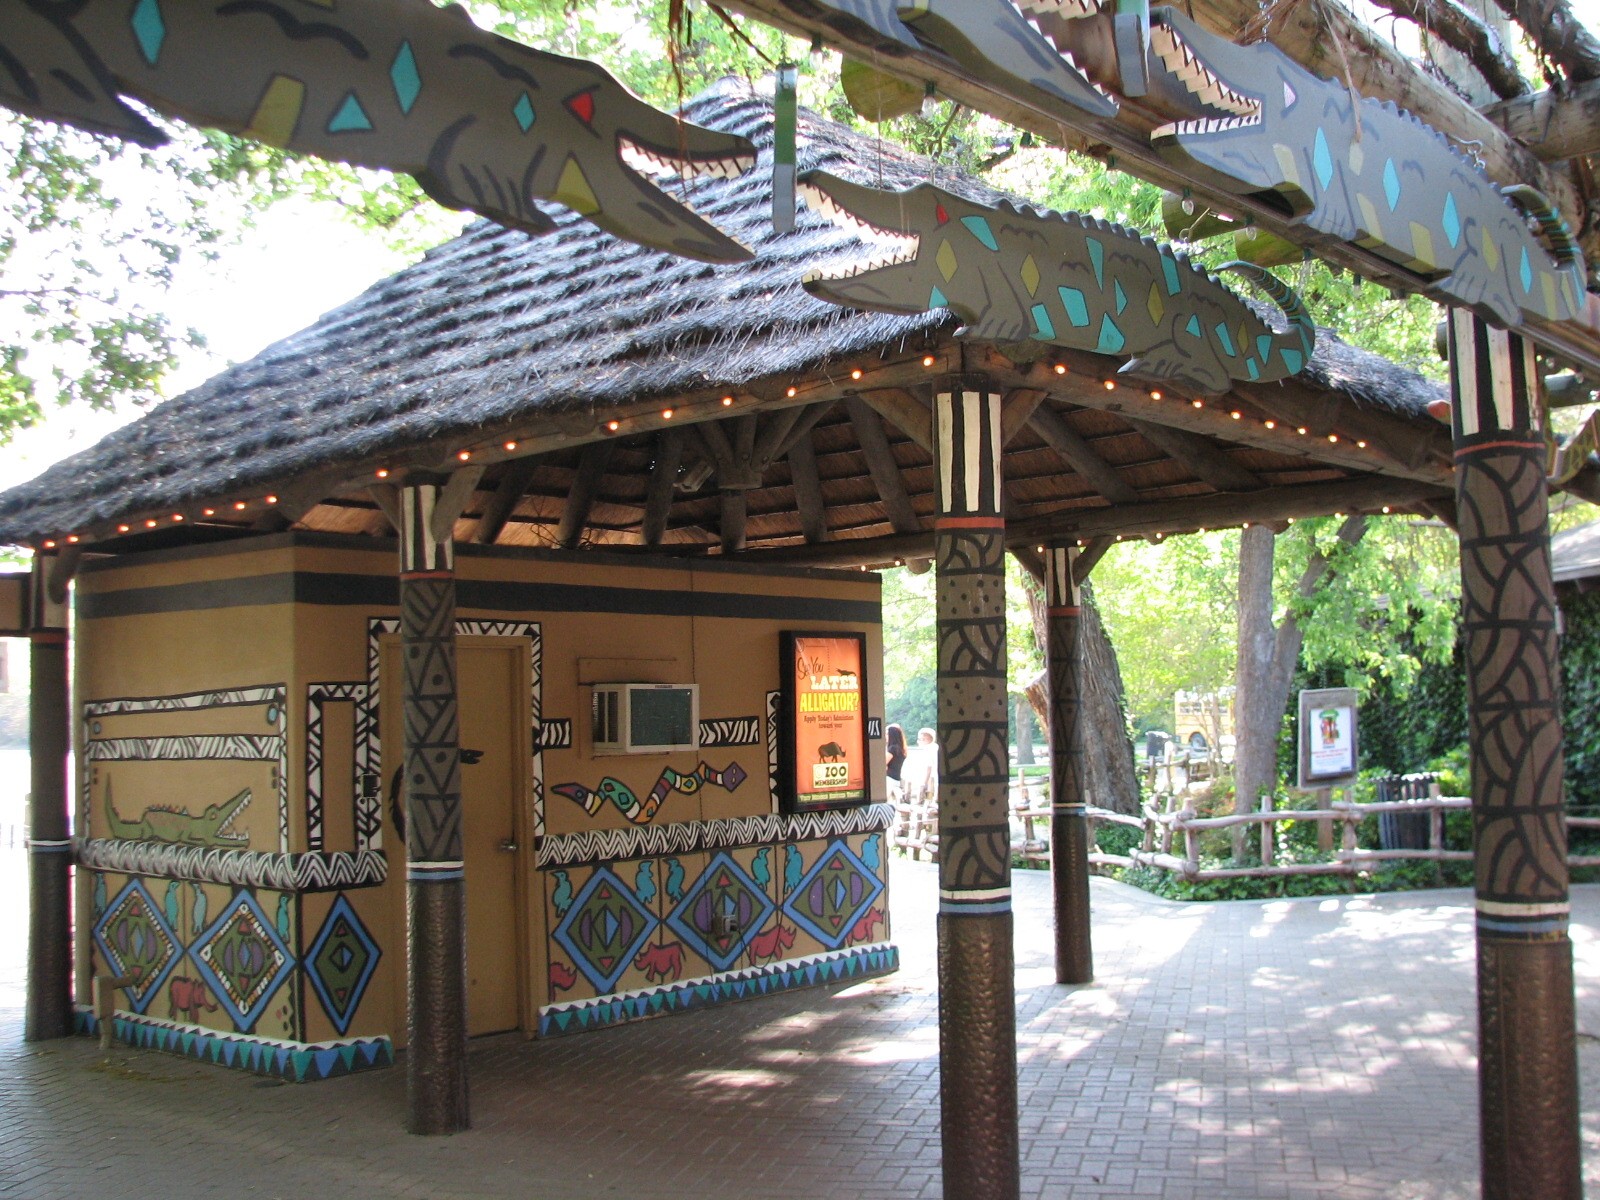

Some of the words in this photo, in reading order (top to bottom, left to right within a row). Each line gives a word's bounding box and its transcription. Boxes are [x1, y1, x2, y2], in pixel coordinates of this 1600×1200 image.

[810, 656, 824, 674] You
[810, 675, 859, 690] LATER
[799, 692, 859, 712] ALLIGATOR?
[825, 765, 847, 778] ZOO
[814, 778, 847, 786] MEMBERSHIP
